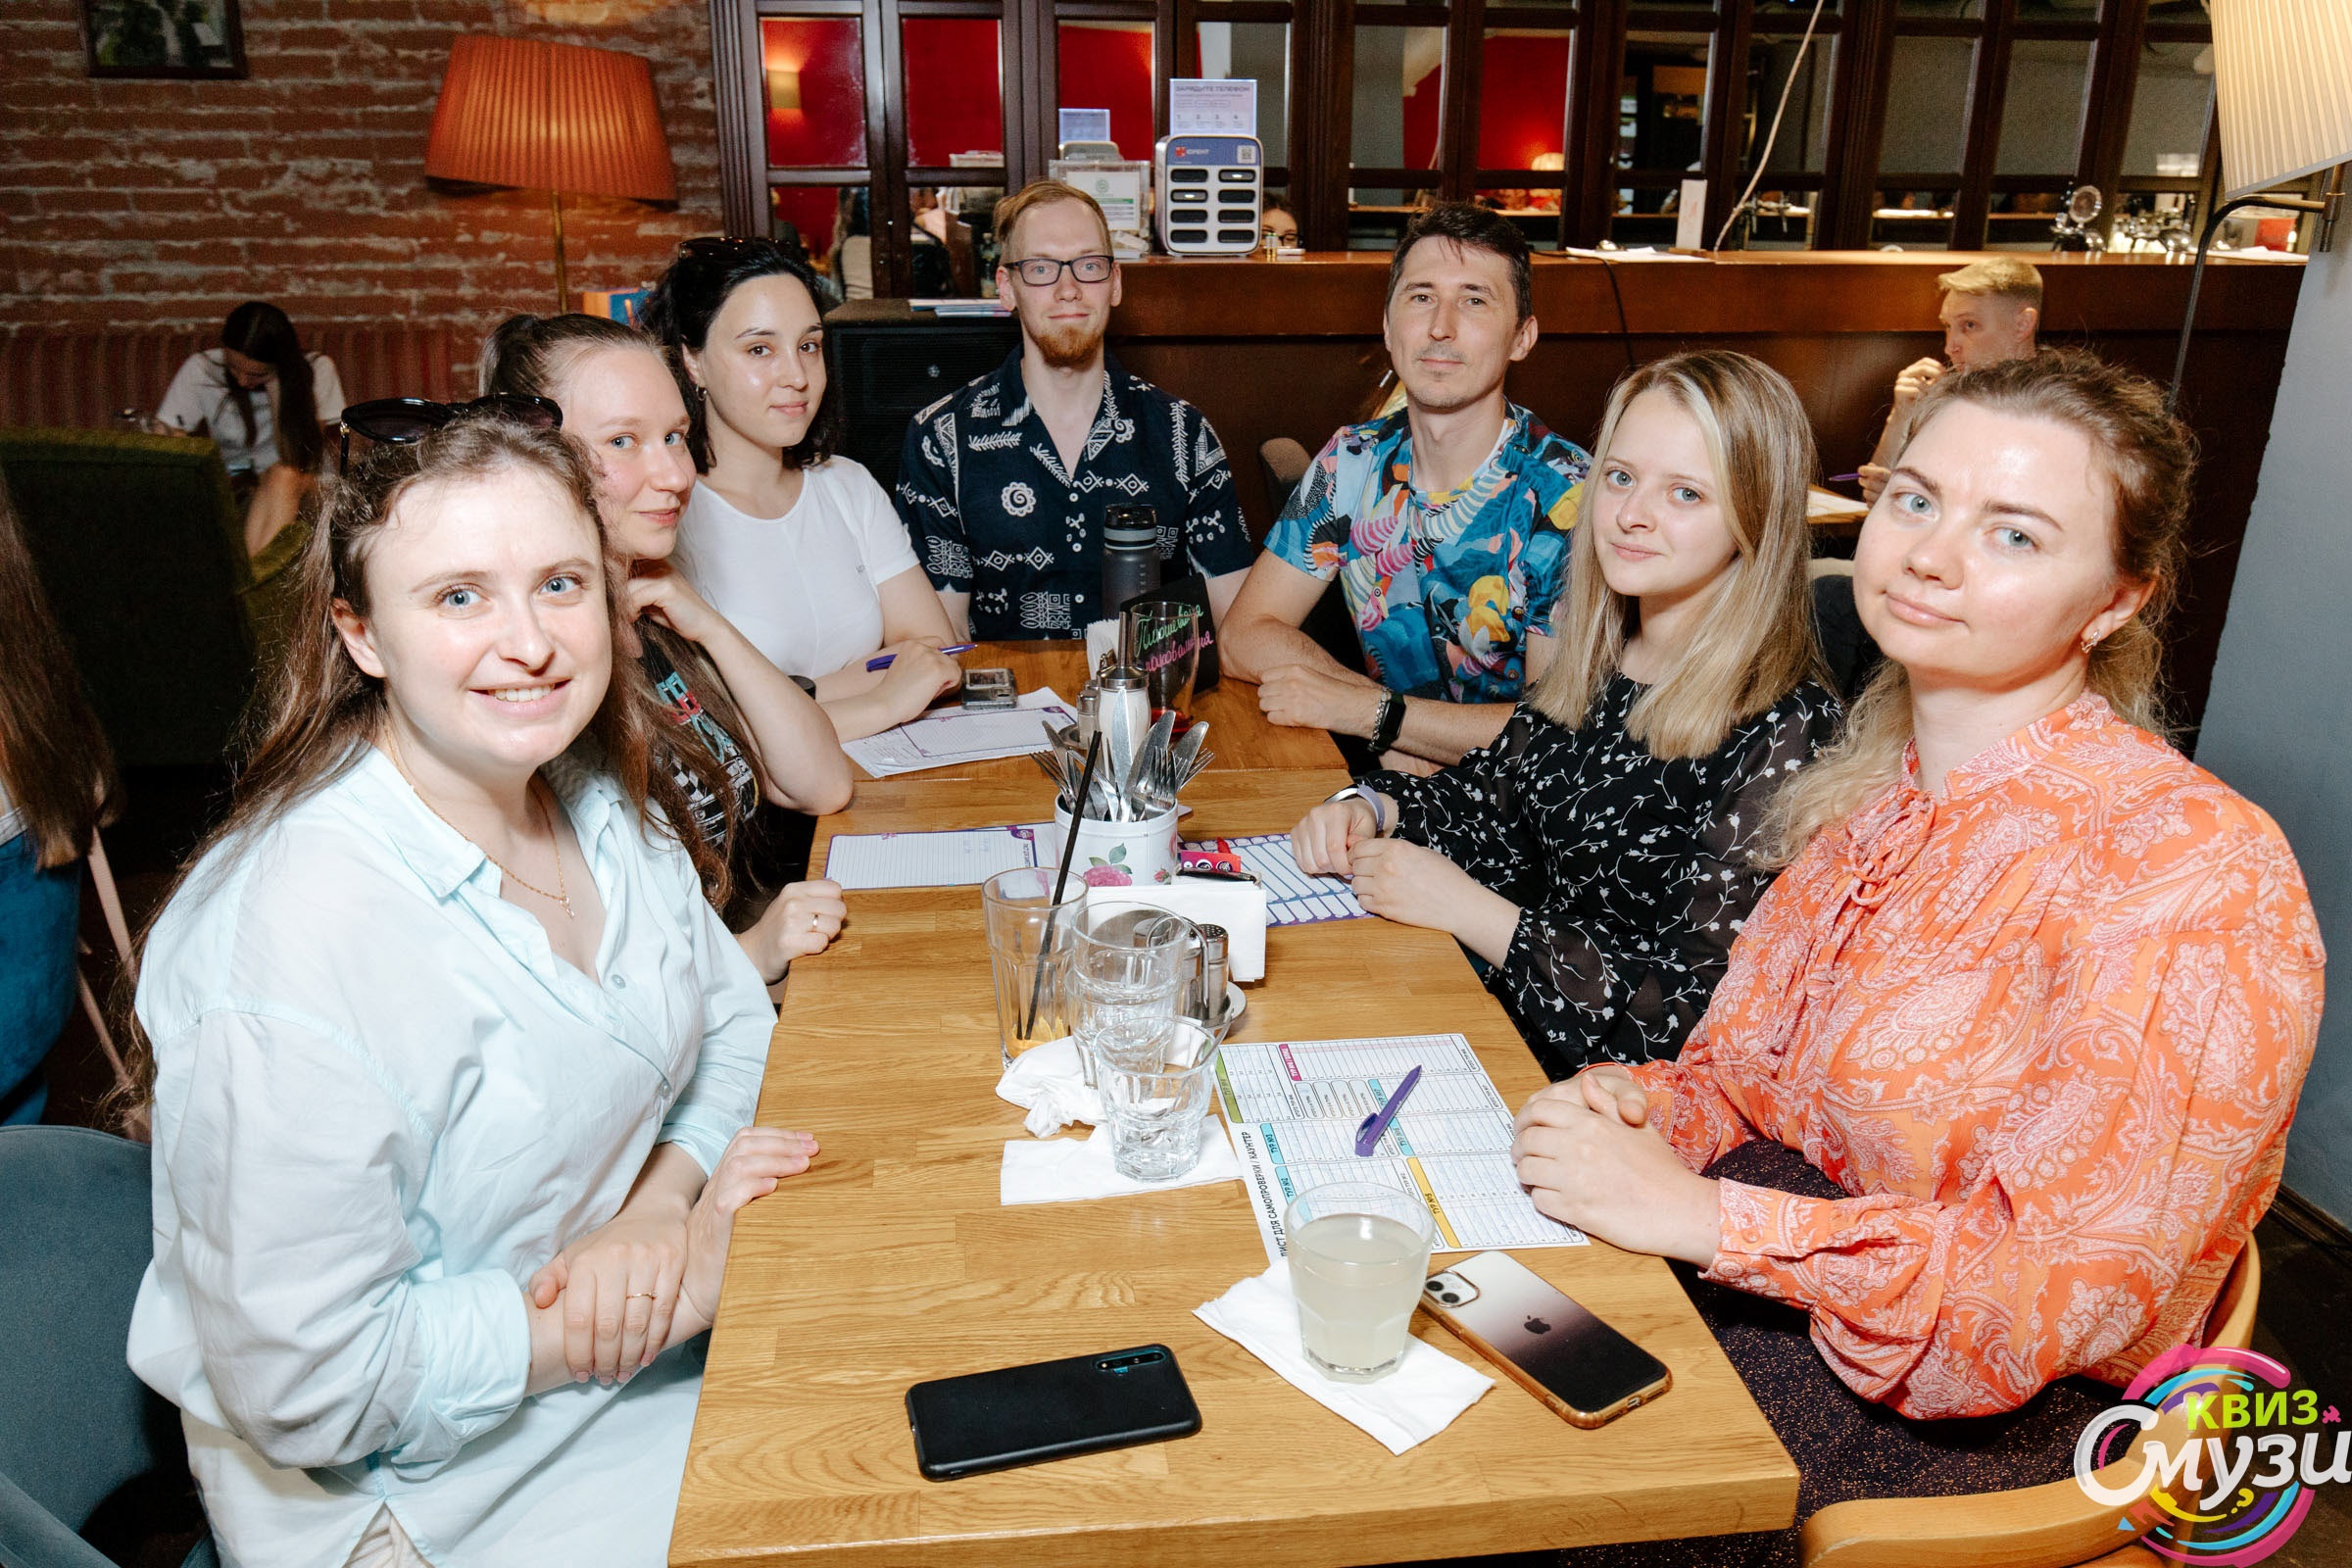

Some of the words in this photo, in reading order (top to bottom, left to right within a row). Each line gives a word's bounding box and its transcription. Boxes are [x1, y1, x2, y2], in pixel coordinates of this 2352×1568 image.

[1242, 1131, 1258, 1159] КАУНТЕР
[1253, 1164, 1278, 1219] САМОПРОВЕРКИ
[1270, 1220, 1285, 1236] ДЛЯ
